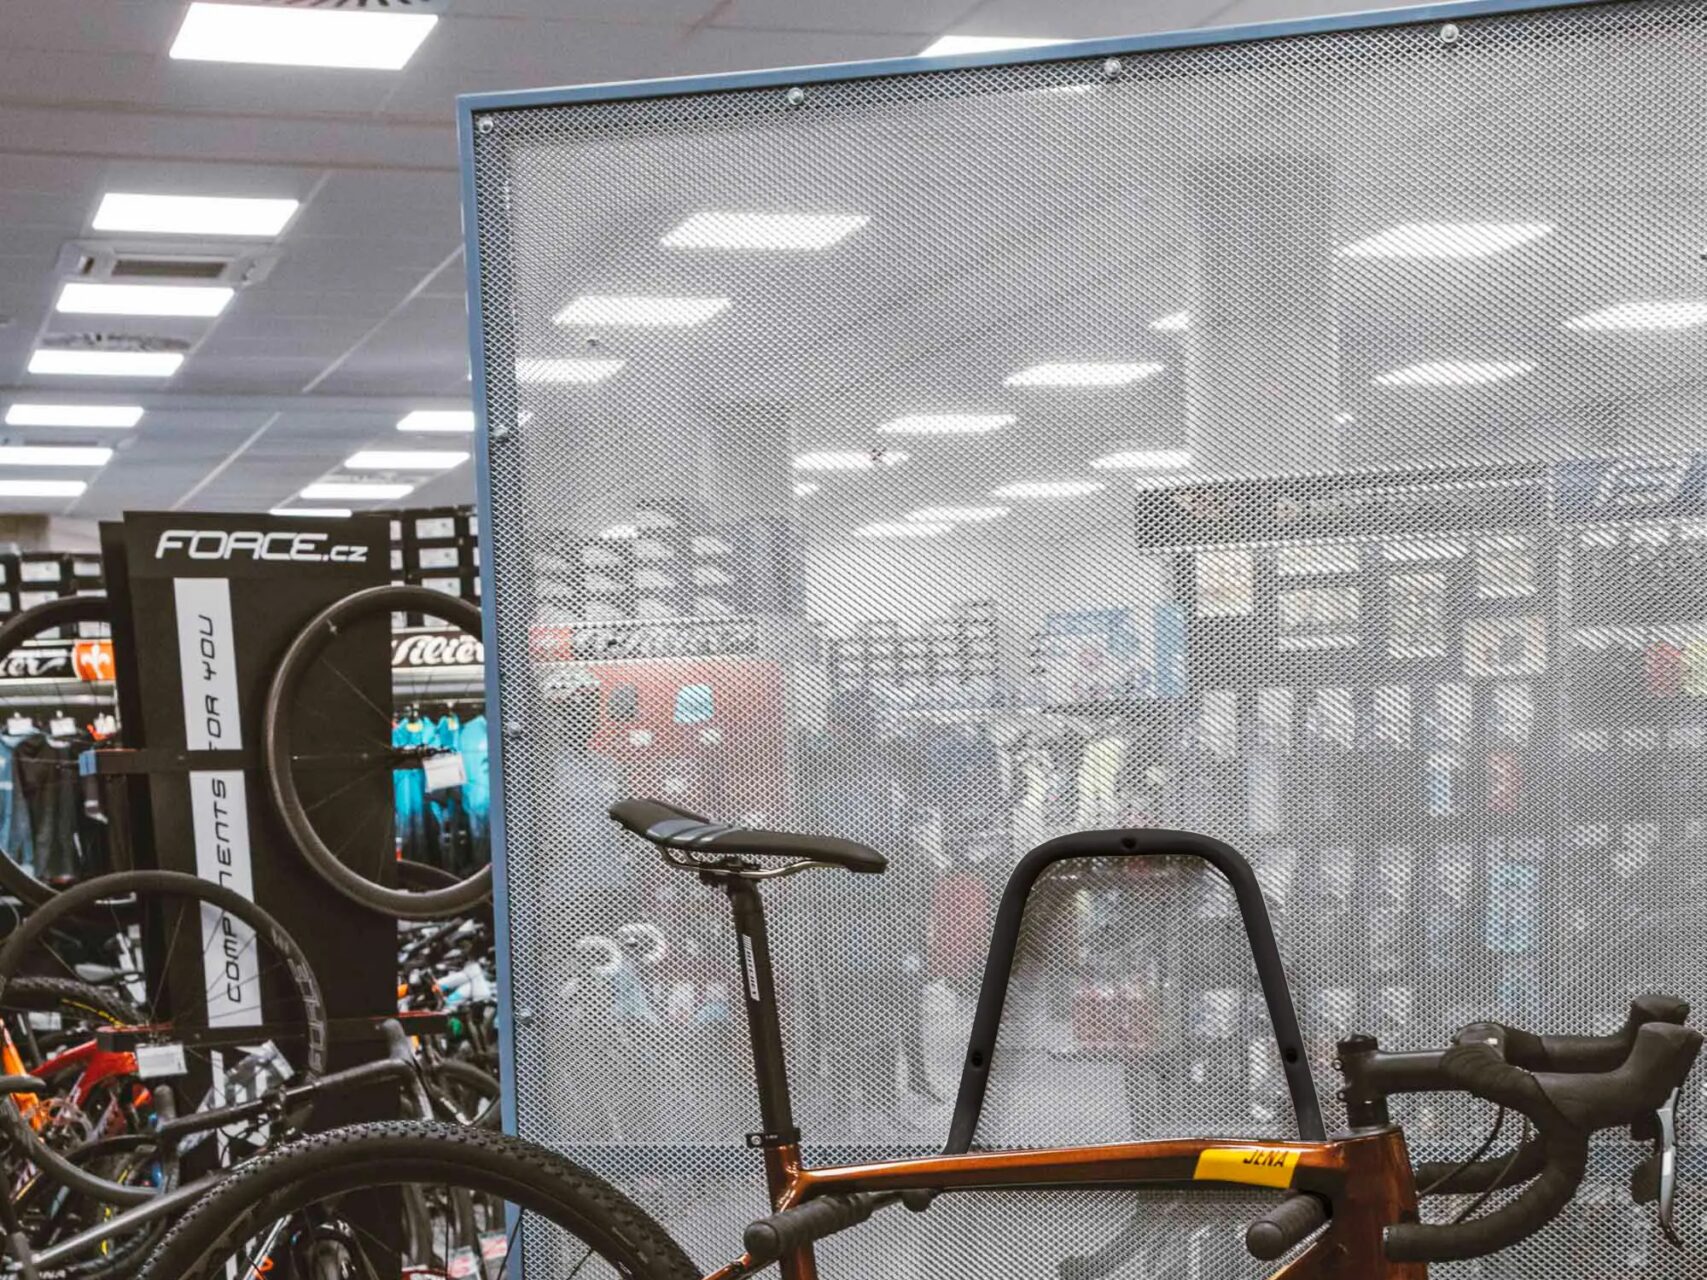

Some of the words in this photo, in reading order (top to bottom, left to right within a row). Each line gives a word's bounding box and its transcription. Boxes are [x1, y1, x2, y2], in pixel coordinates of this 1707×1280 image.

[155, 530, 368, 562] FORCE.cz
[212, 777, 242, 1003] COMPNENTS
[1243, 1150, 1289, 1168] JENA
